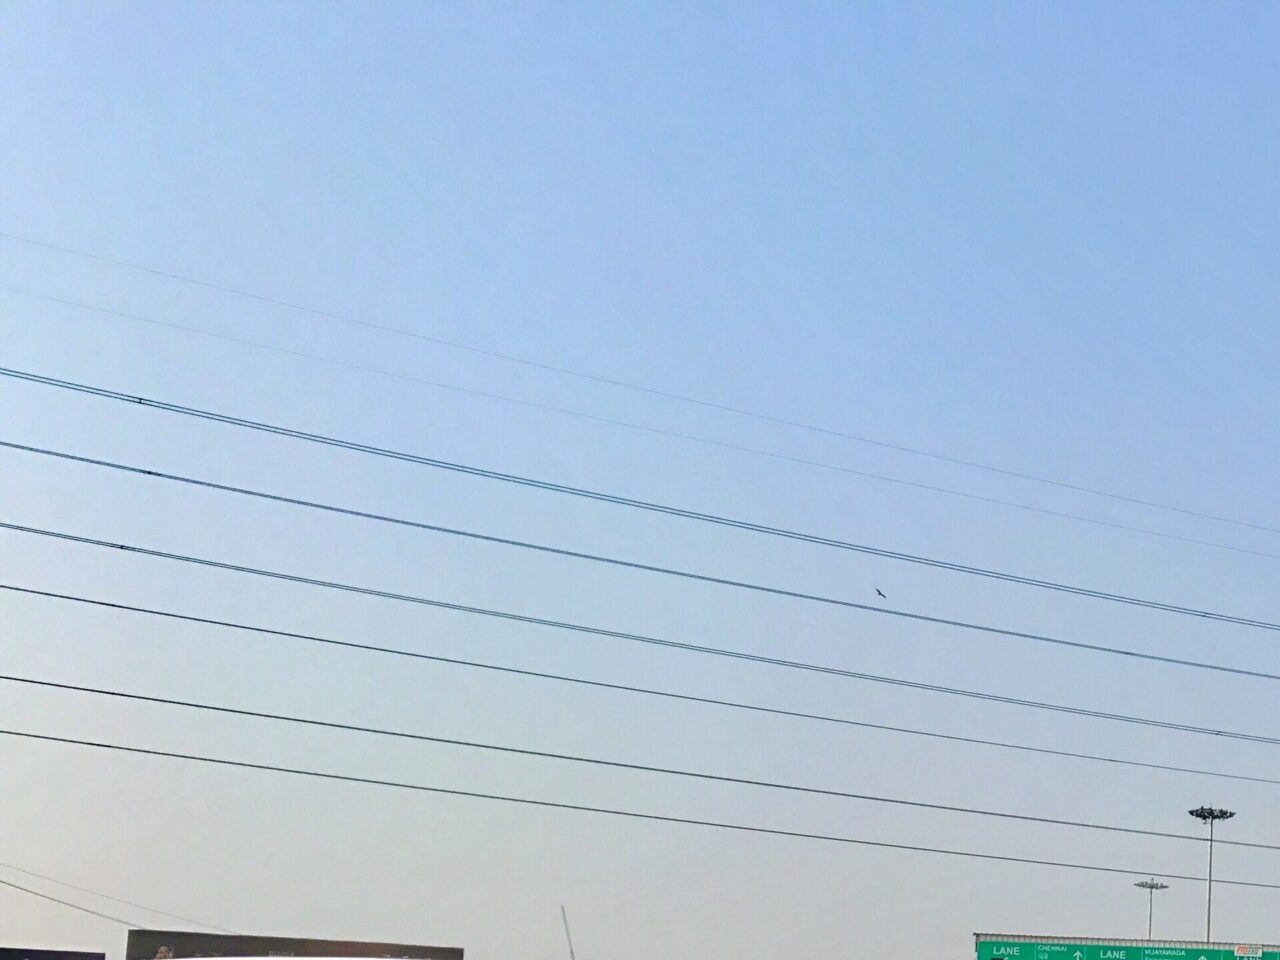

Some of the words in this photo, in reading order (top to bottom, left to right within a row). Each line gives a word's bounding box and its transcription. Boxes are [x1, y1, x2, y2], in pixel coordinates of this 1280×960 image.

[993, 946, 1020, 956] LANE
[1037, 944, 1068, 952] CHENNAI
[1144, 948, 1186, 956] VIJAYAWADA
[1100, 950, 1127, 960] LANE
